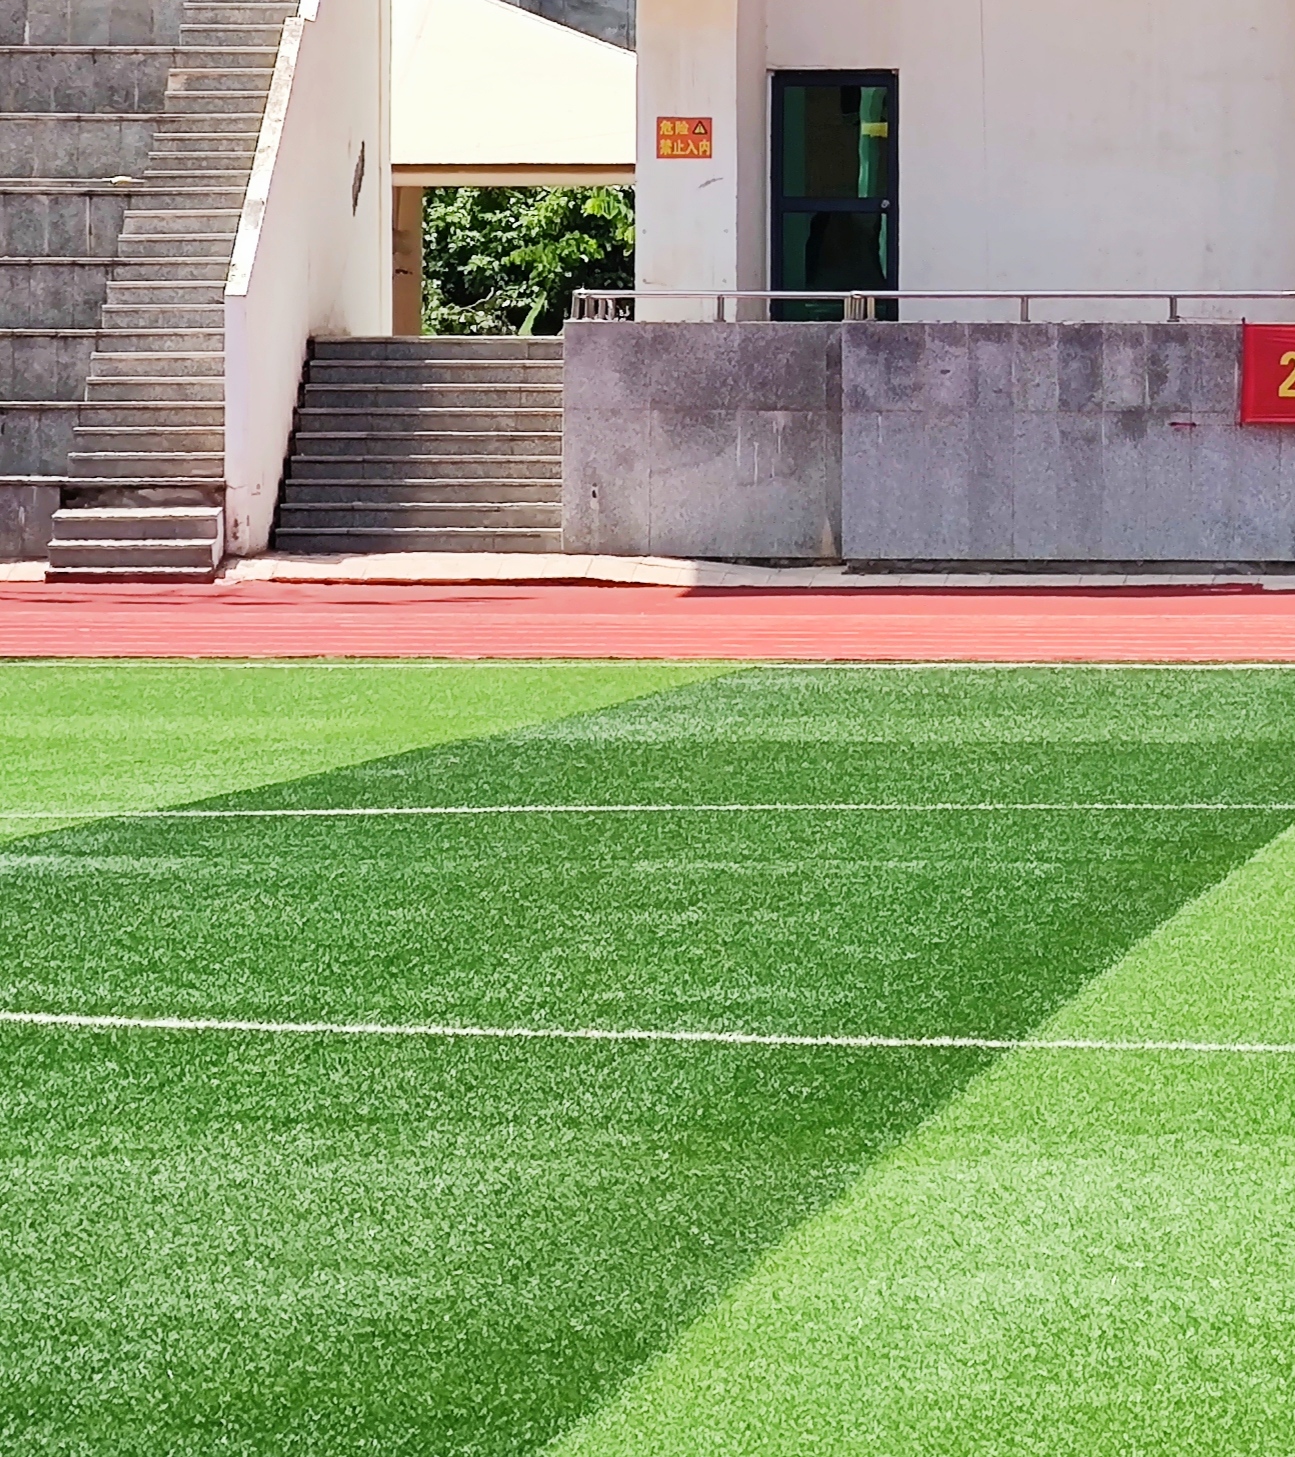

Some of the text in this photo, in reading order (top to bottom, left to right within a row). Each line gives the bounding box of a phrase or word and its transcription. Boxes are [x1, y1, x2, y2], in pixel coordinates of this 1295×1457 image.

[660, 120, 690, 136] 危险
[660, 139, 710, 156] 禁止入内
